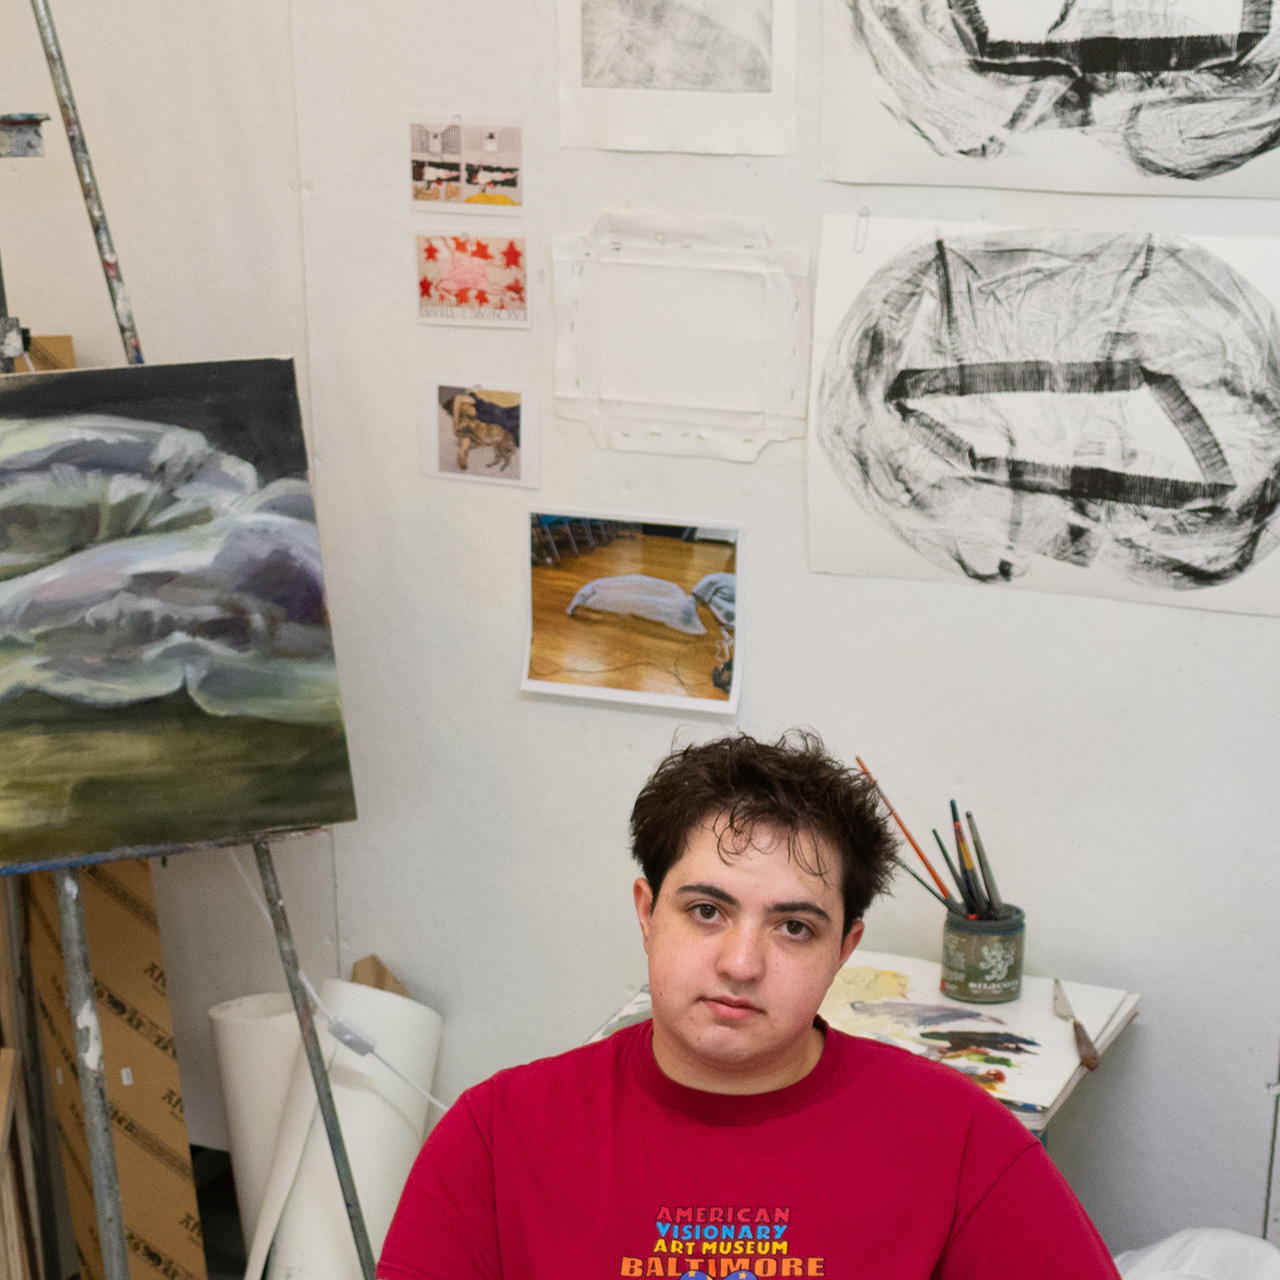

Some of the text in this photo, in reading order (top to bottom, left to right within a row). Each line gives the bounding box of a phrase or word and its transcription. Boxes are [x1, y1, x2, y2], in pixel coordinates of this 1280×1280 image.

[656, 1206, 791, 1224] AMERICAN
[655, 1222, 788, 1241] VISIONARY
[653, 1238, 789, 1256] ART MUSEUM
[620, 1256, 826, 1278] BALTIMORE
